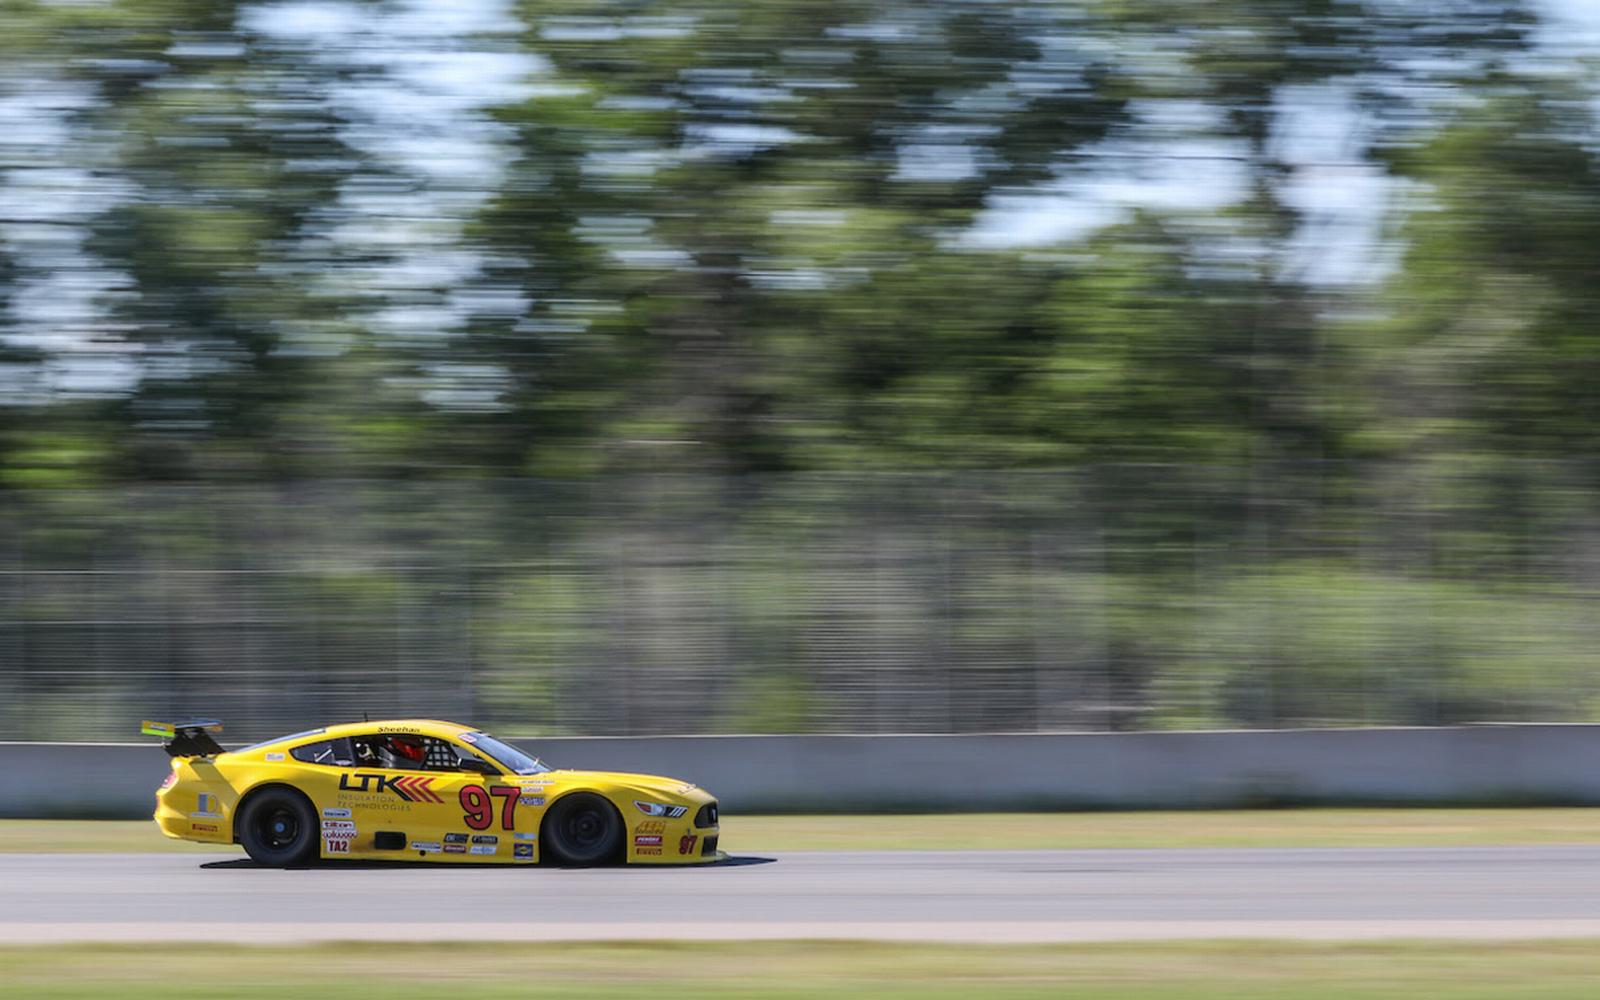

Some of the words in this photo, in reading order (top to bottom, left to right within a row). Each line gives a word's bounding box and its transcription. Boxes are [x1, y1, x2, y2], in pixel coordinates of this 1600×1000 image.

[339, 774, 414, 802] LTK
[337, 794, 396, 802] INSULATION
[337, 801, 412, 811] TECHNOLOGIES
[459, 784, 521, 831] 97
[328, 840, 348, 852] TA2
[679, 834, 699, 855] 97
